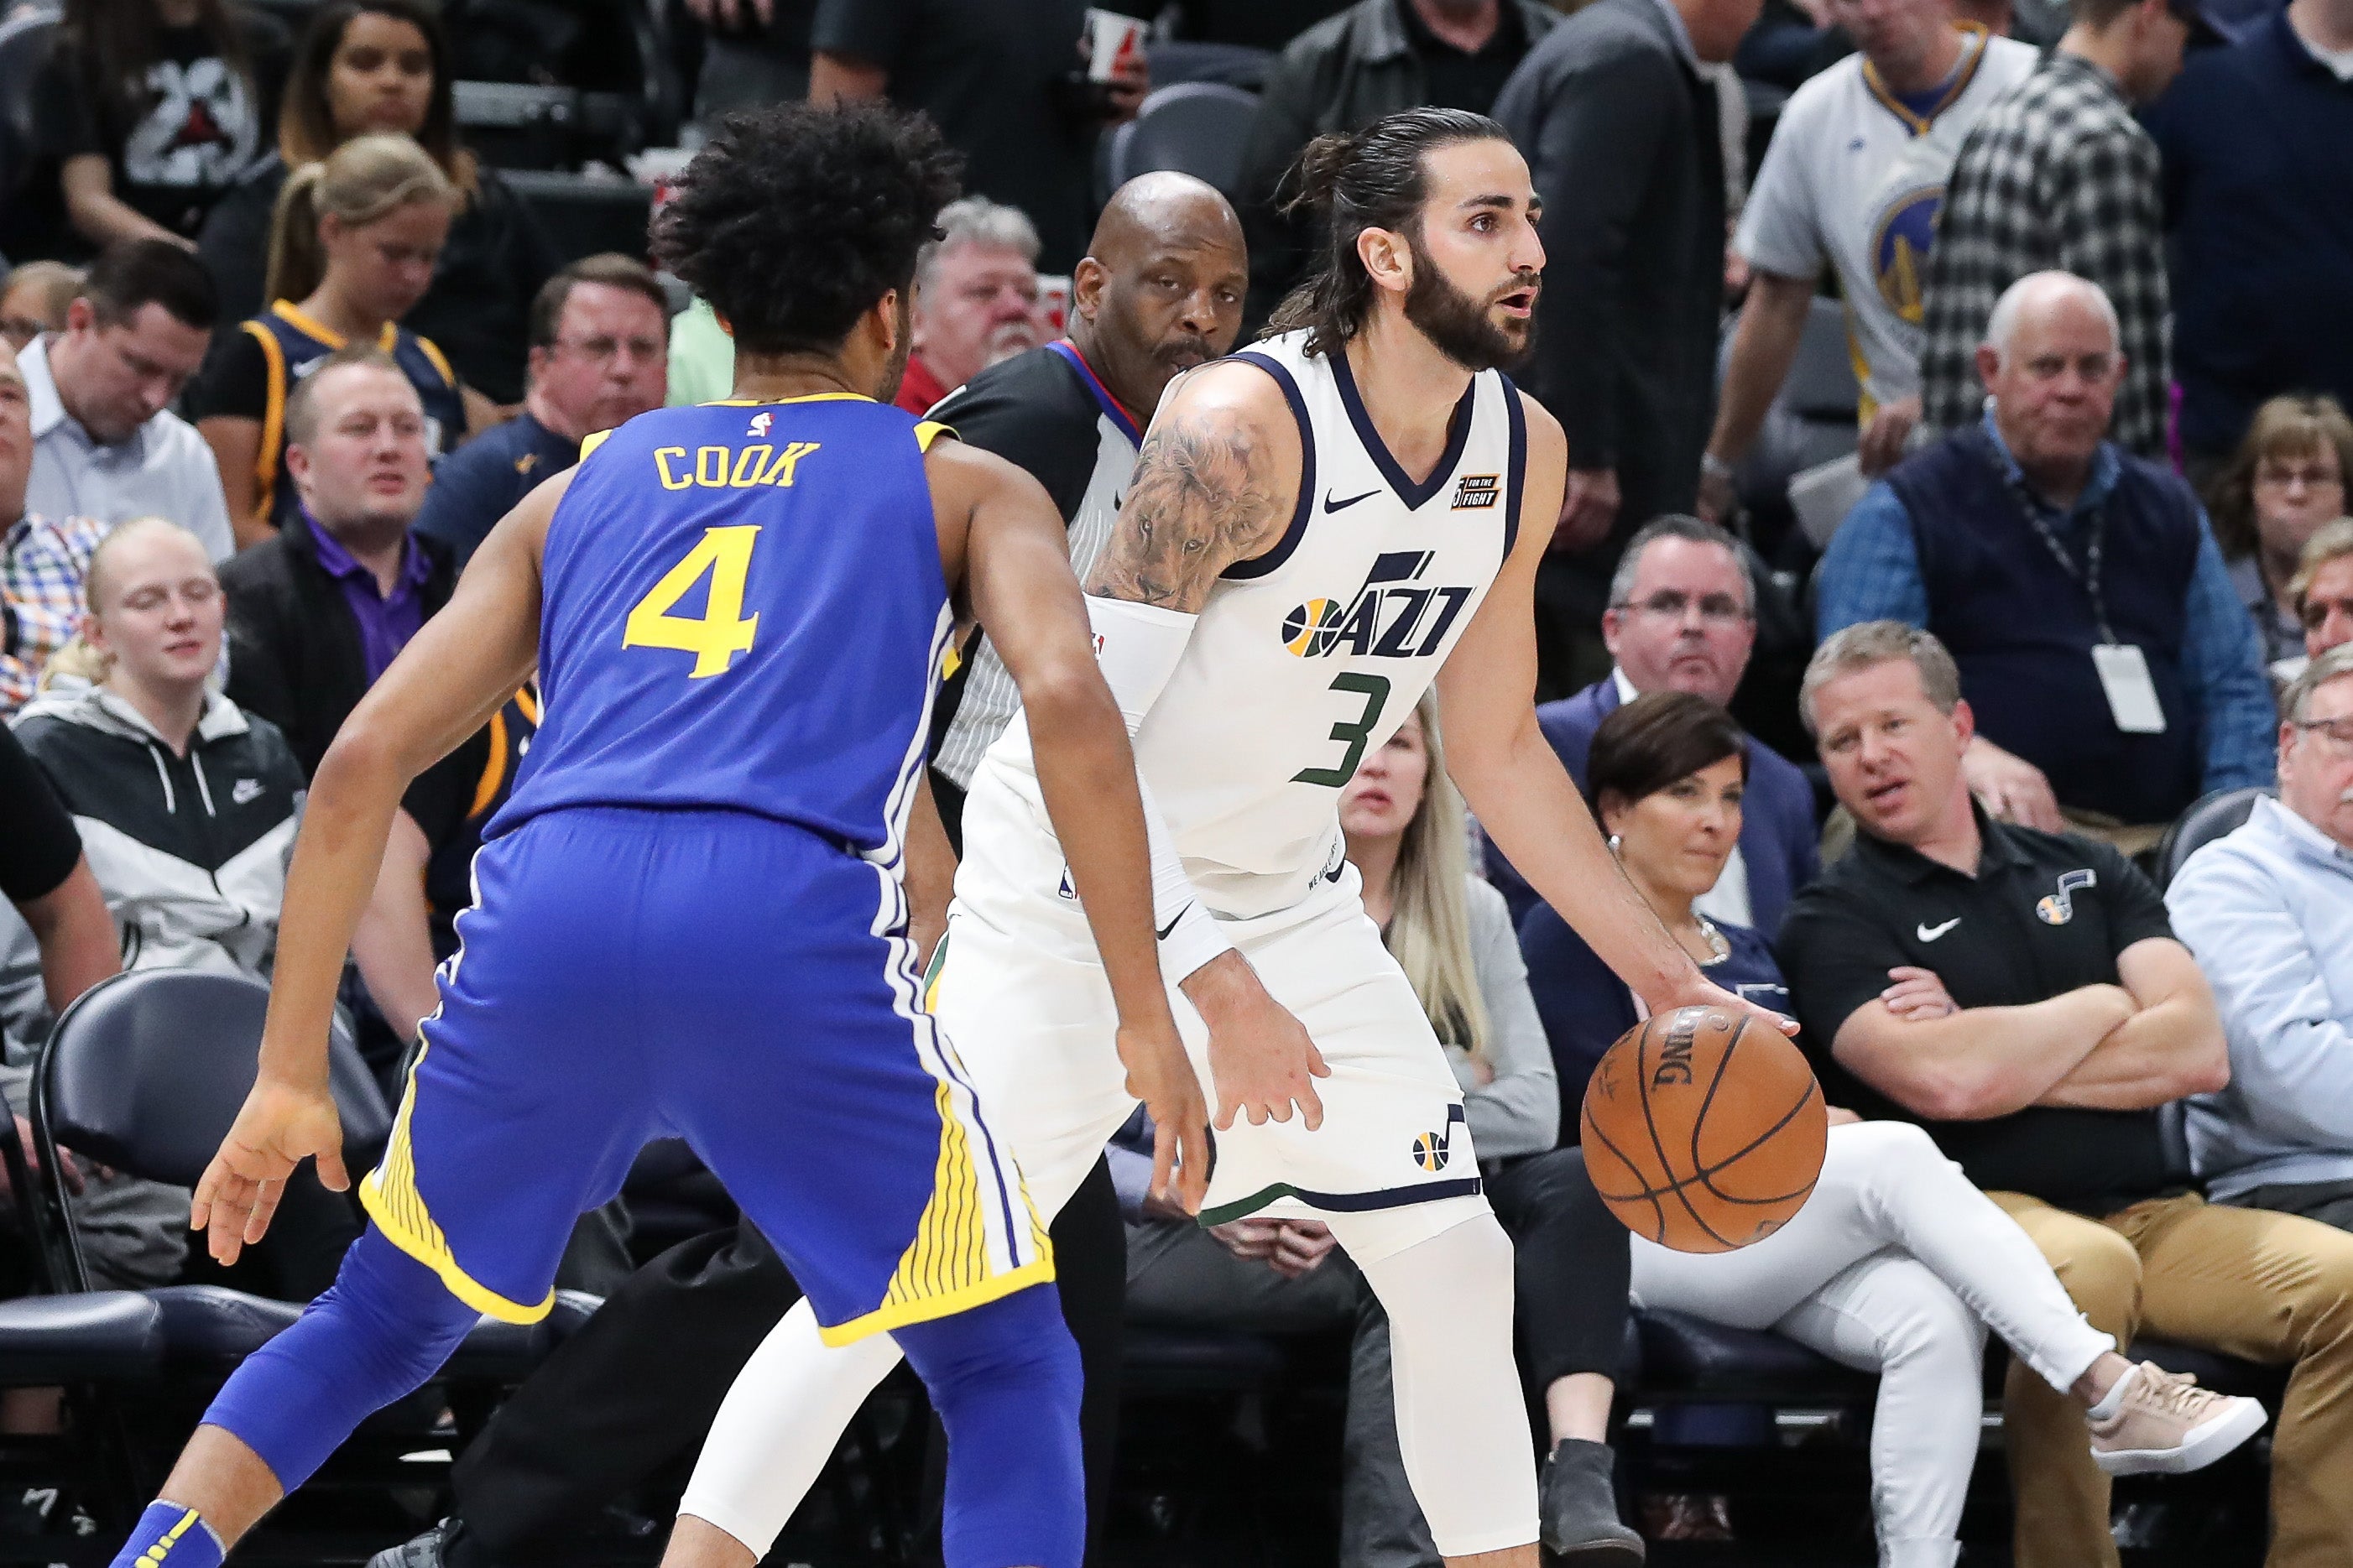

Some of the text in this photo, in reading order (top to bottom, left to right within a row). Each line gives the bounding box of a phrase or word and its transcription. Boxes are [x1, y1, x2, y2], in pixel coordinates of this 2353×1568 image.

[654, 442, 822, 491] COOK
[1480, 478, 1493, 487] THE
[1462, 492, 1495, 506] FIGHT
[620, 524, 763, 679] 4
[1288, 672, 1390, 788] 3
[1308, 874, 1318, 891] WE
